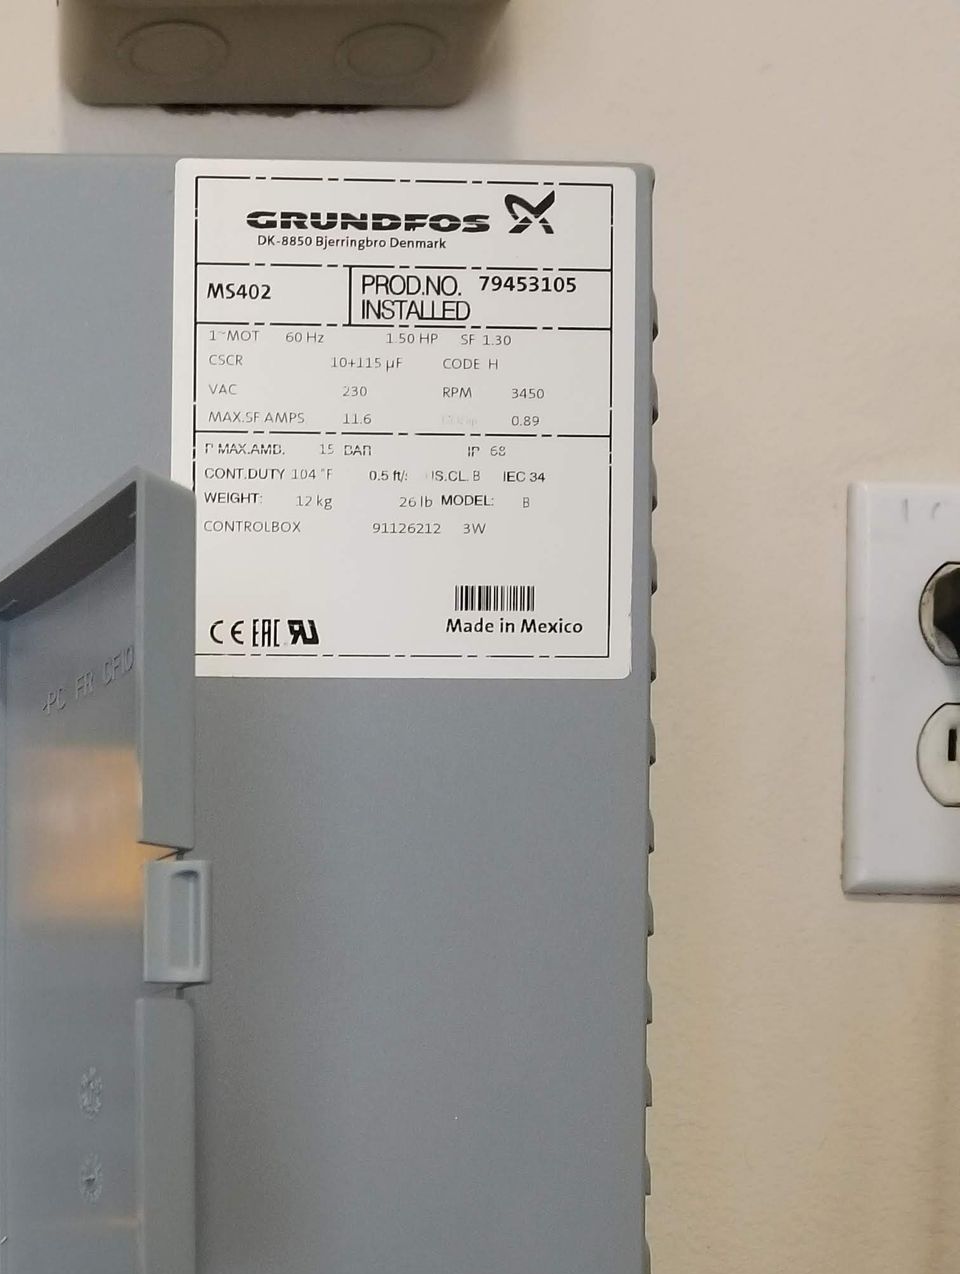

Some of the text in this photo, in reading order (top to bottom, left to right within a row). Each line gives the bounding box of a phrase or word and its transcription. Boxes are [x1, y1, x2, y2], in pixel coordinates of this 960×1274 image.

[246, 210, 490, 233] GRUNDFOS
[257, 236, 446, 251] DK-8850 Bjerringbro Denmark
[206, 283, 272, 300] MS402
[362, 275, 577, 297] PROD.NO. 79453105
[361, 300, 472, 321] INSTALLED
[285, 332, 303, 343] 60
[306, 332, 325, 344] Hz
[386, 333, 415, 345] 1.50
[419, 333, 439, 345] HP
[461, 334, 476, 346] SF
[483, 335, 512, 346] 1.30
[208, 354, 499, 371] CSCR 10+115 CODE H
[208, 384, 545, 400] VAC 230 RPM 3450
[208, 411, 540, 427] MAX.SF AMPS 11.6 0.89
[204, 467, 286, 480] CONT.DUTY
[291, 468, 317, 480] 104
[369, 470, 389, 481] 0.5
[503, 472, 526, 483] IEC
[529, 472, 546, 483] 34
[204, 492, 530, 510] WEIGHT: 12 kg 26 lb MODEL: B
[204, 521, 486, 534] CONTROLBOX 91126212 3W
[446, 618, 583, 634] Made in Mexico
